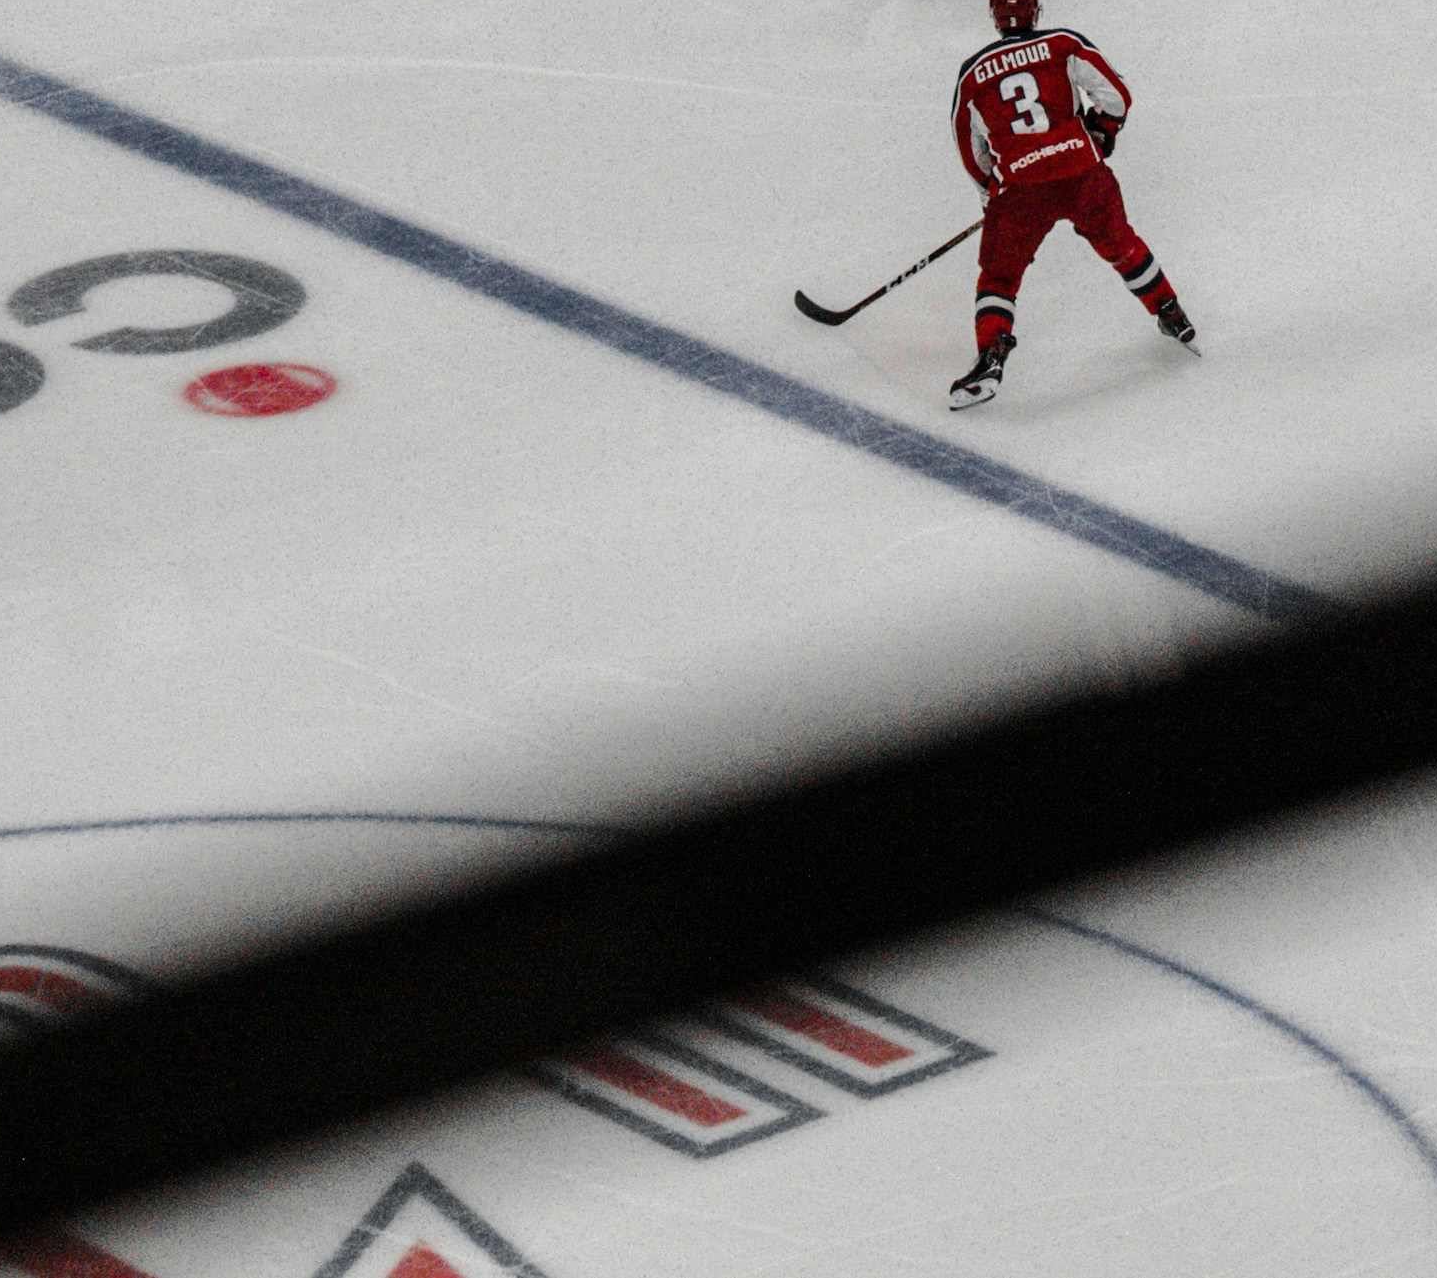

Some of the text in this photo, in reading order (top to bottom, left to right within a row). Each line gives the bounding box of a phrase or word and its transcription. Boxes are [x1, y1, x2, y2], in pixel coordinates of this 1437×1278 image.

[974, 42, 1051, 84] GILMOUR
[999, 72, 1050, 134] 3
[1010, 138, 1084, 173] РОСНЕФТЬ
